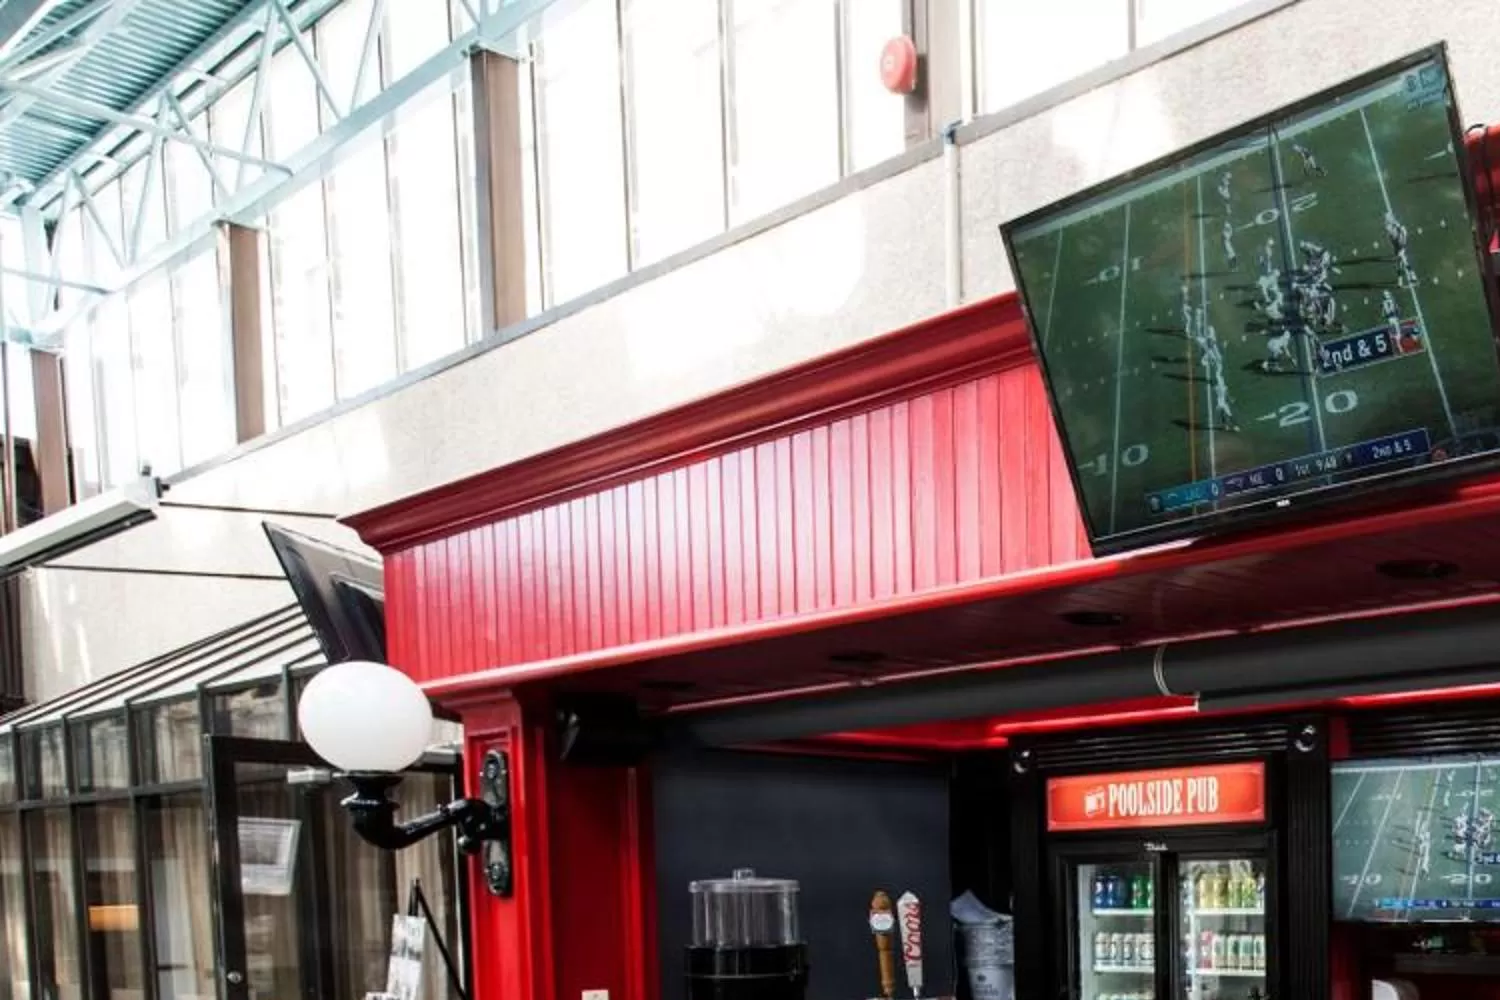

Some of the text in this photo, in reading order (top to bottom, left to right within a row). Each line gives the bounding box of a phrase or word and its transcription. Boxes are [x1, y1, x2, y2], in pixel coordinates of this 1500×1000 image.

[1321, 333, 1388, 368] 2nd & 5
[1278, 388, 1359, 428] 20
[1107, 778, 1184, 817] POOLSIDE
[1186, 775, 1219, 813] PUB
